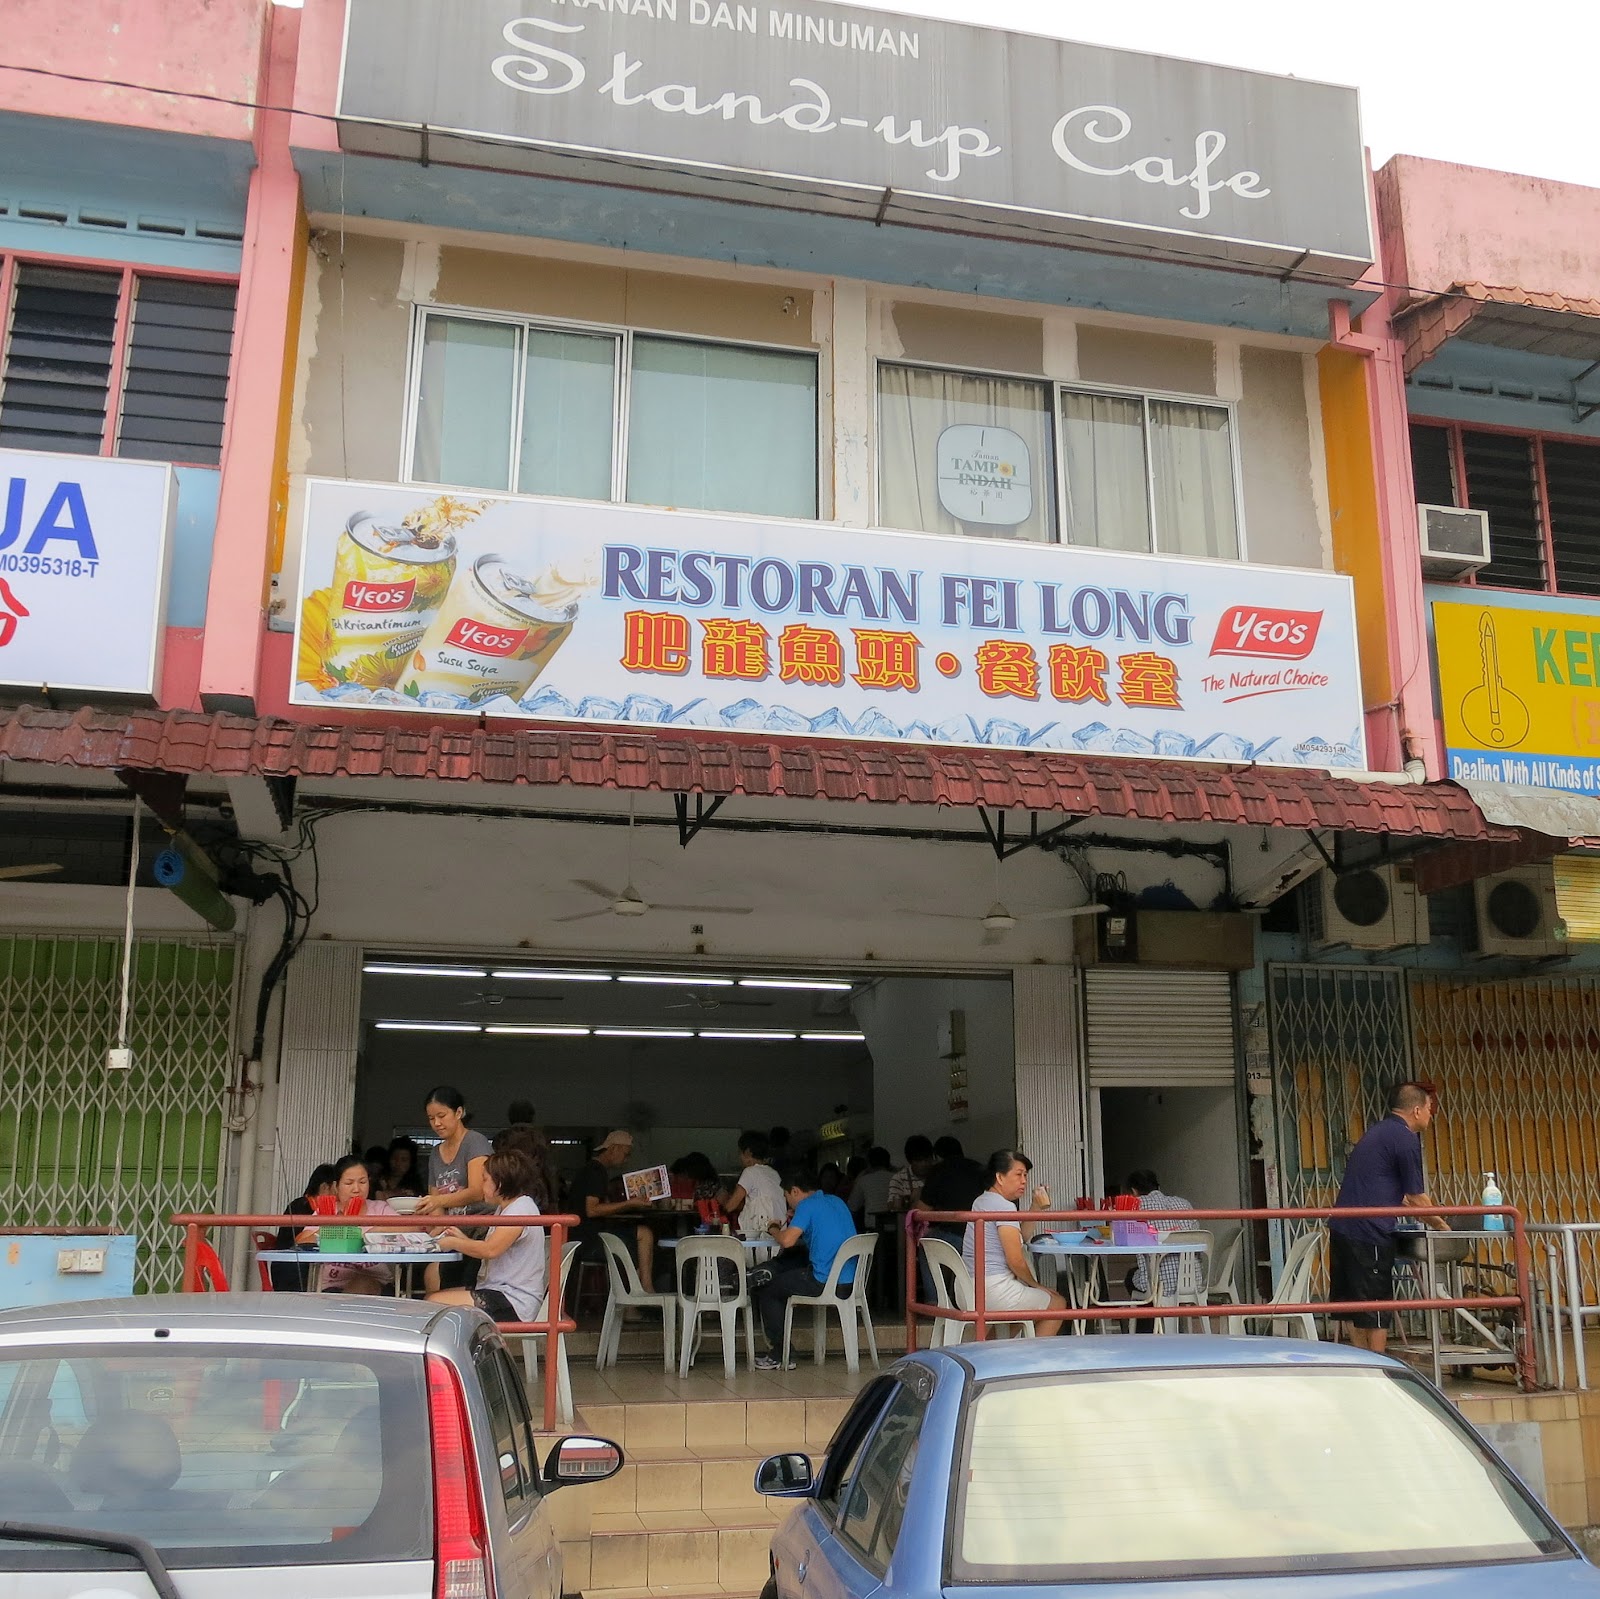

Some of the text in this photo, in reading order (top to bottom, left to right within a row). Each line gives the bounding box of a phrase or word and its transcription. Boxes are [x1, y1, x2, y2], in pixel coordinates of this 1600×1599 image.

[689, 0, 757, 34] DAN
[769, 10, 920, 59] MINUMAN
[491, 17, 1271, 219] Stand-up Cafe
[602, 544, 1194, 647] RESTORAN FEI LONG
[437, 651, 499, 677] Susu Soya
[1201, 669, 1328, 692] The Natural Choice
[1453, 756, 1500, 782] Dealing
[1502, 759, 1529, 786] With
[1532, 761, 1547, 787] All
[1548, 762, 1582, 790] Kinds
[1583, 765, 1594, 790] of
